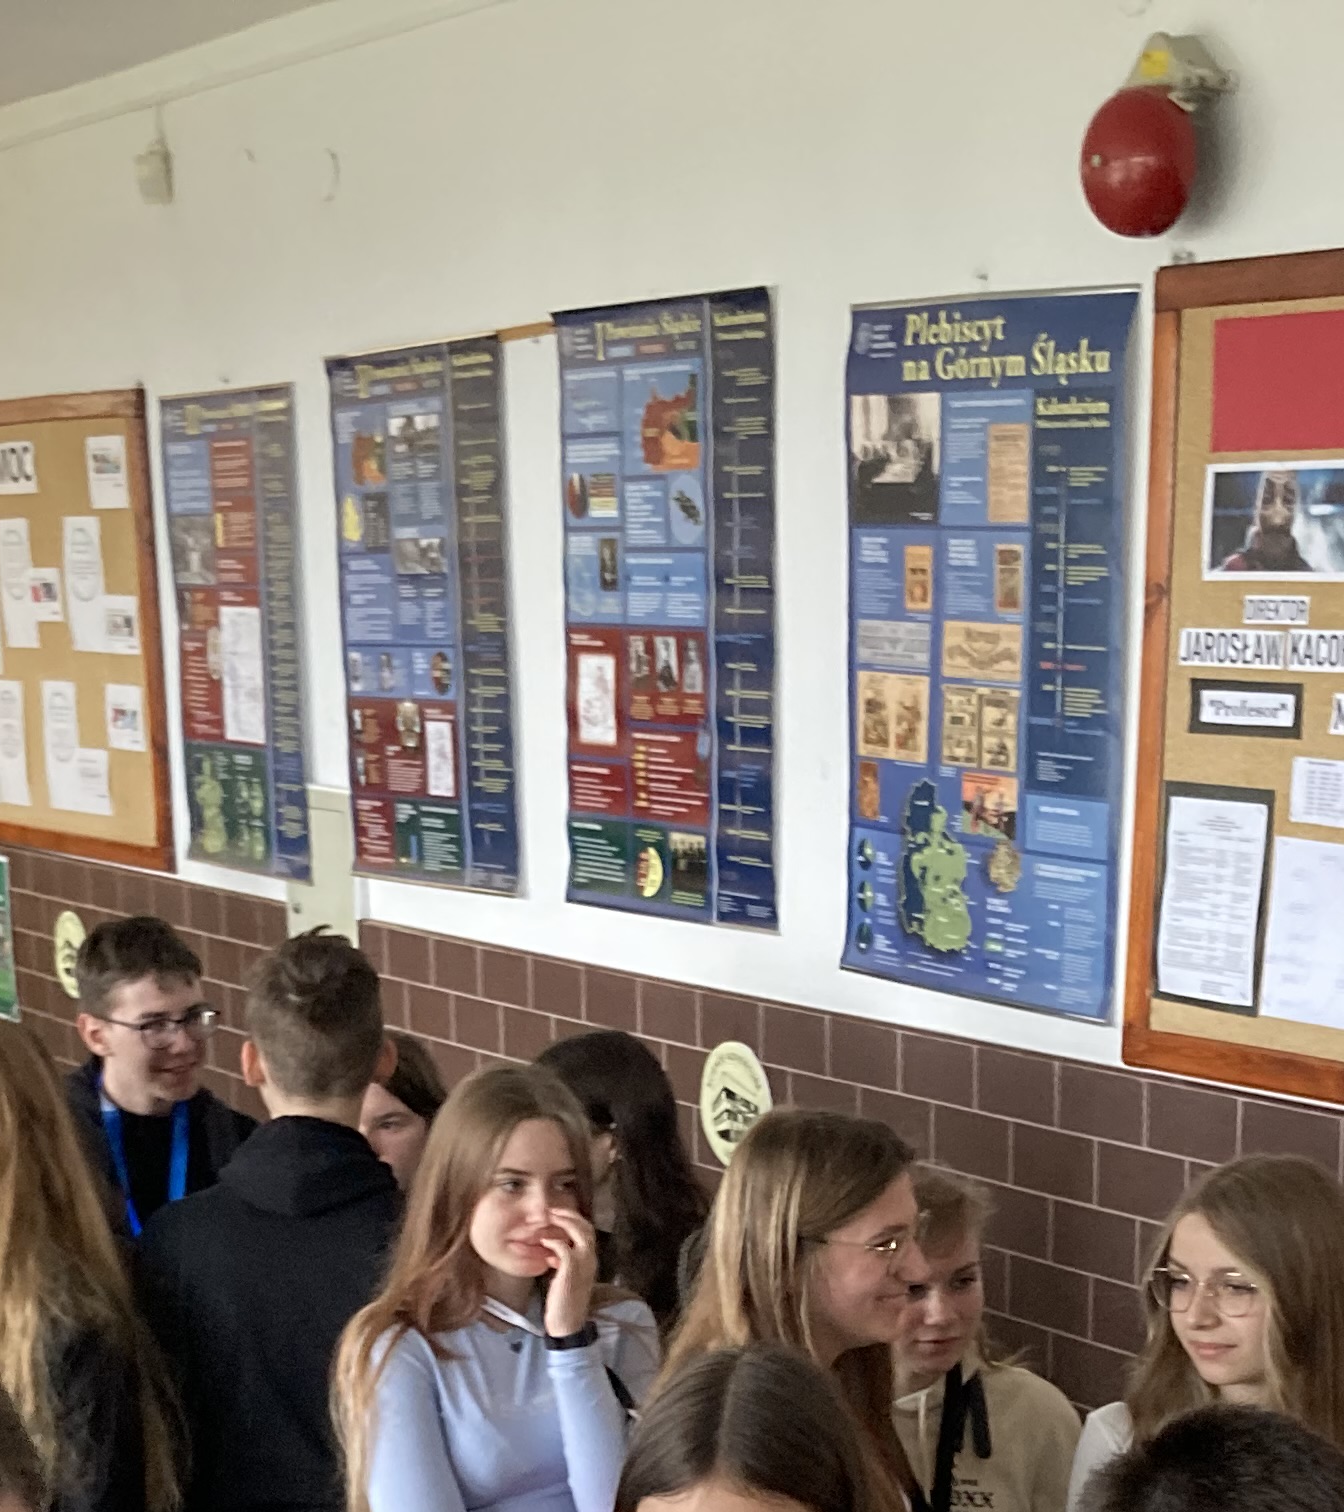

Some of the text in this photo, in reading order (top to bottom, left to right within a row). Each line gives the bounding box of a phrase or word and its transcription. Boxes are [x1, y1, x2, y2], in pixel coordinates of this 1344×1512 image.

[903, 311, 1006, 354] Plebiscyt
[901, 332, 1112, 388] na Górnym Śląsku
[1181, 631, 1281, 665] JAROSŁAW
